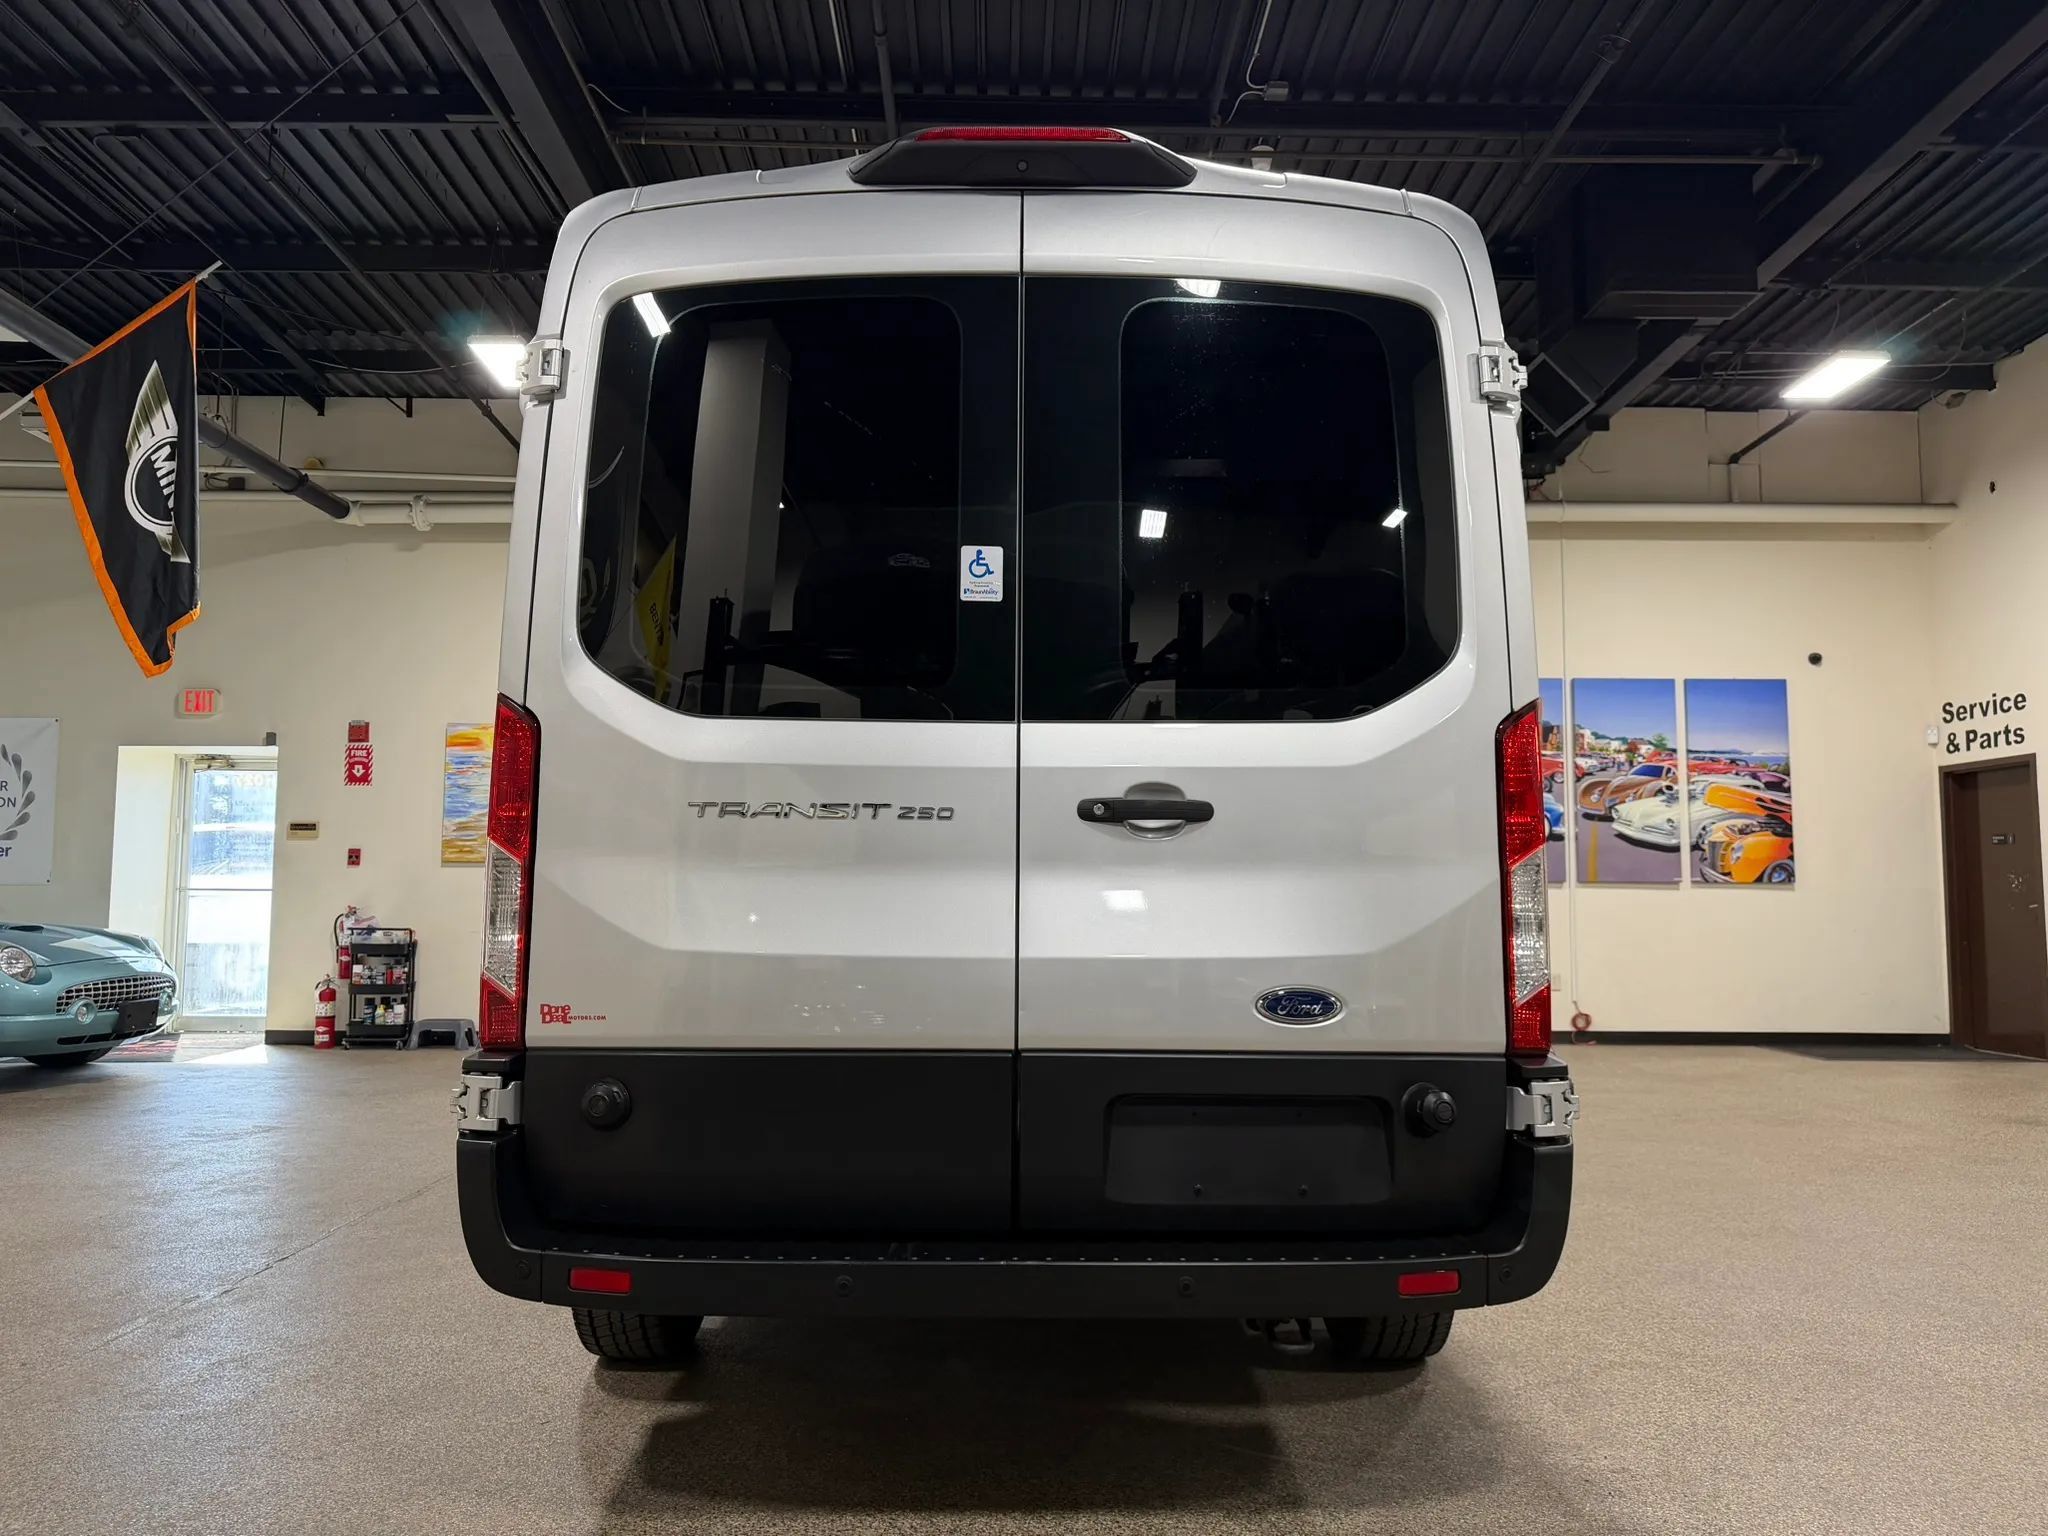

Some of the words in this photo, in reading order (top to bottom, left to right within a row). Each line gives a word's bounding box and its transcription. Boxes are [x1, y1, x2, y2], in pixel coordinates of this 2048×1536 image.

[184, 690, 215, 713] EXIT
[1942, 692, 2027, 724] Service
[1946, 731, 1961, 755] &
[1965, 723, 2025, 752] Parts
[350, 749, 369, 757] FIRE
[688, 801, 893, 820] TRANSIT
[896, 805, 955, 821] 250
[1276, 995, 1324, 1016] Ford
